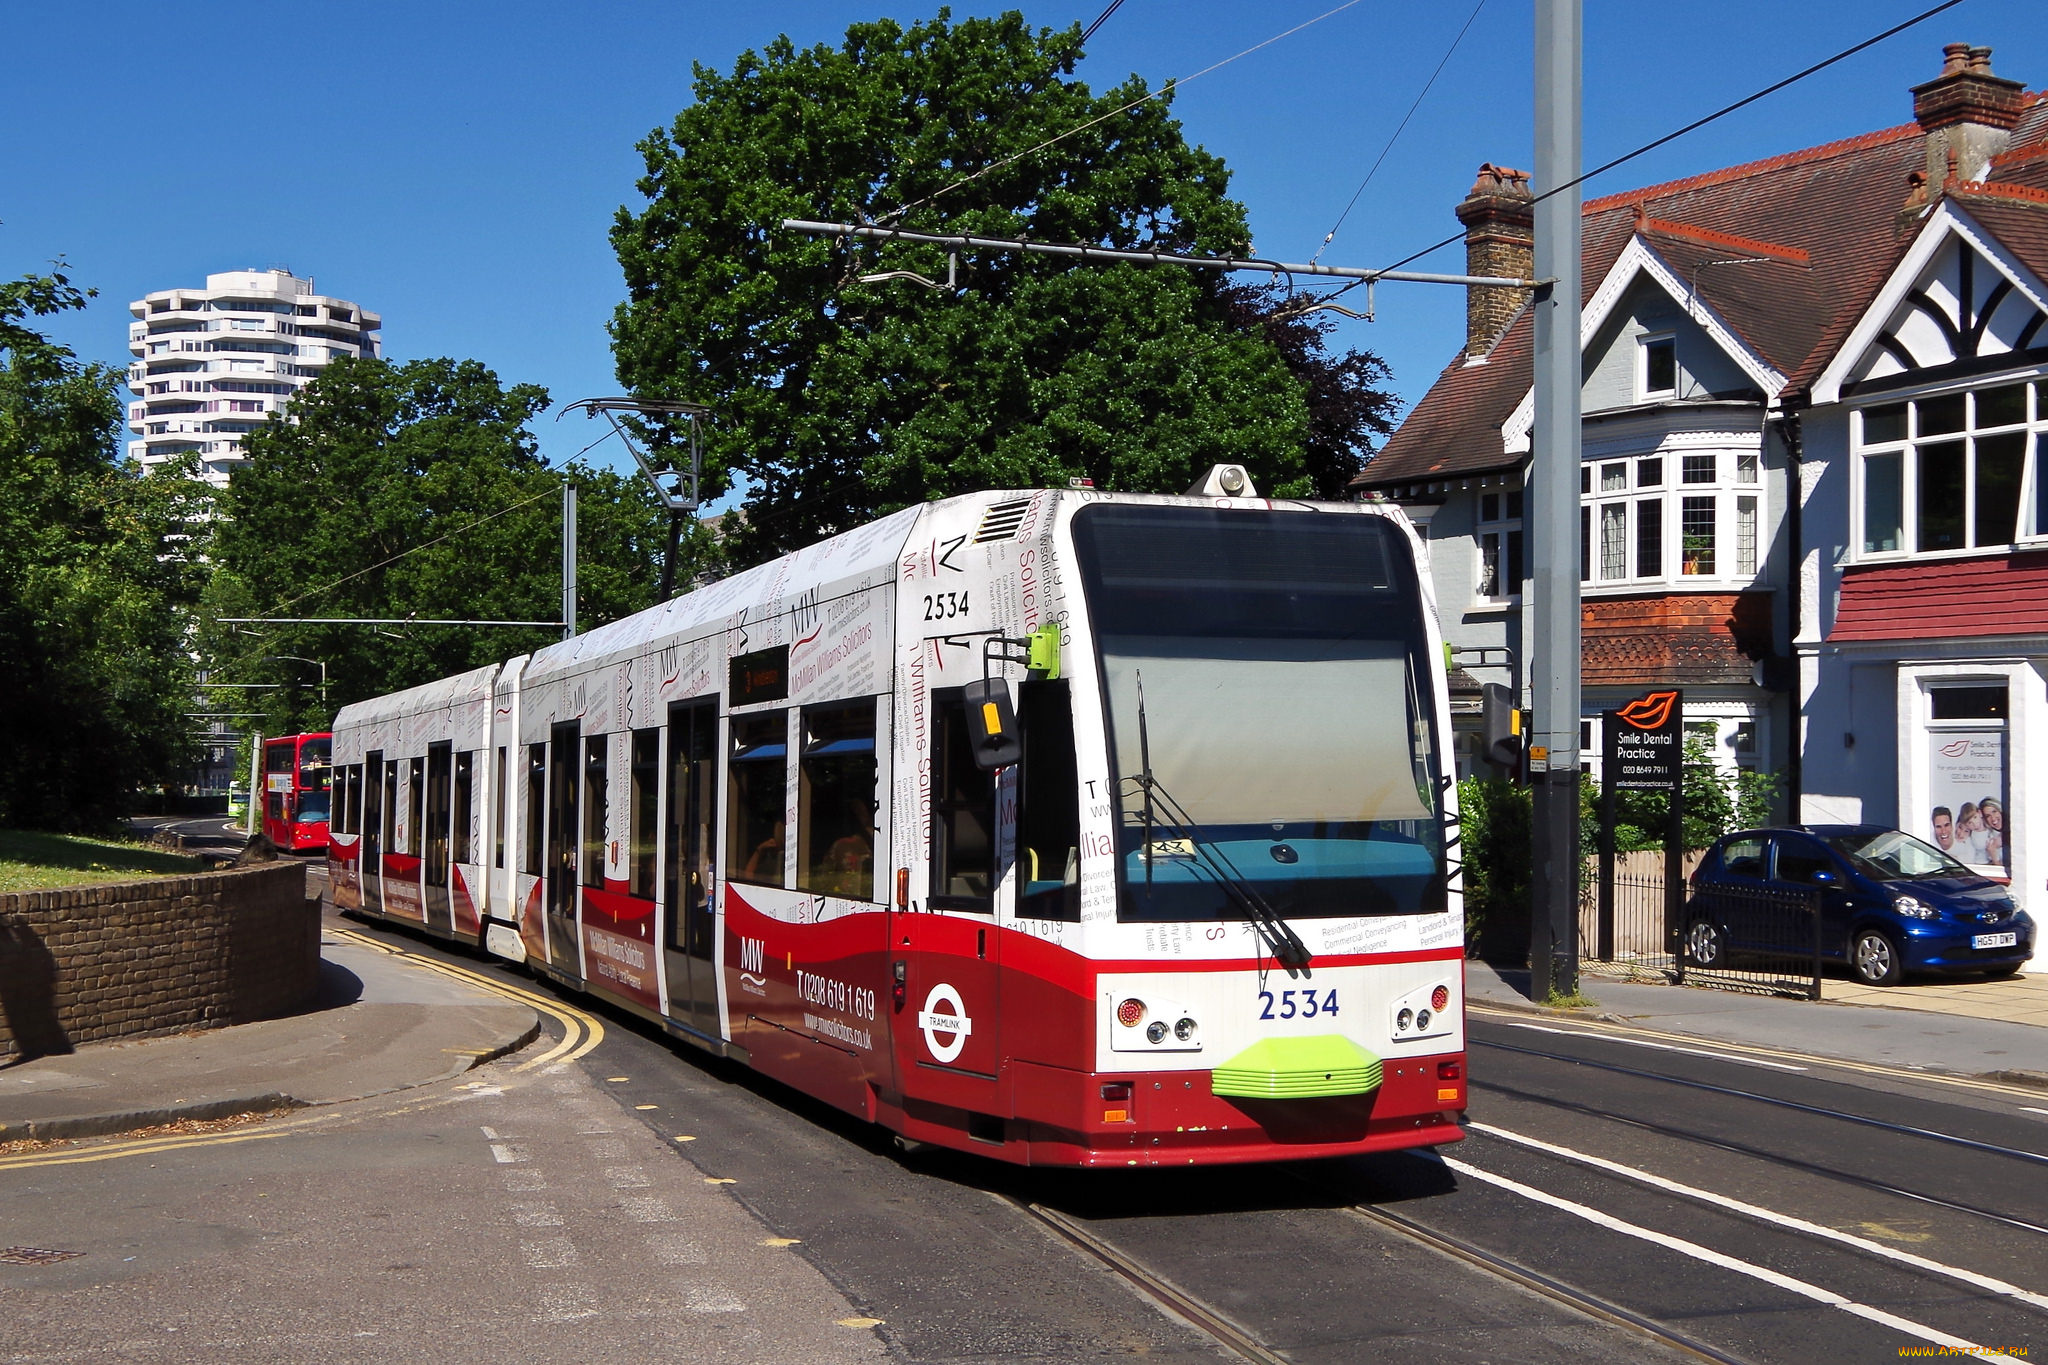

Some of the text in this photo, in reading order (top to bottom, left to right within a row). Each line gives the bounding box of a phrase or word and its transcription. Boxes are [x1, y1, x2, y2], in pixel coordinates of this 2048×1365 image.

[791, 582, 822, 642] MW
[923, 590, 969, 621] 2534
[842, 622, 872, 658] Solicitors
[910, 655, 927, 751] Williams
[1617, 732, 1673, 745] Smile Dental
[1617, 746, 1656, 759] Practice
[1622, 765, 1668, 775] 020 8649 7911
[741, 936, 765, 974] MW
[797, 970, 804, 998] T
[804, 972, 826, 1006] 0208
[827, 979, 845, 1012] 619
[847, 984, 852, 1014] 1
[856, 986, 875, 1021] 619
[1258, 988, 1340, 1020] 2534
[929, 1016, 960, 1030] TRAMLINK
